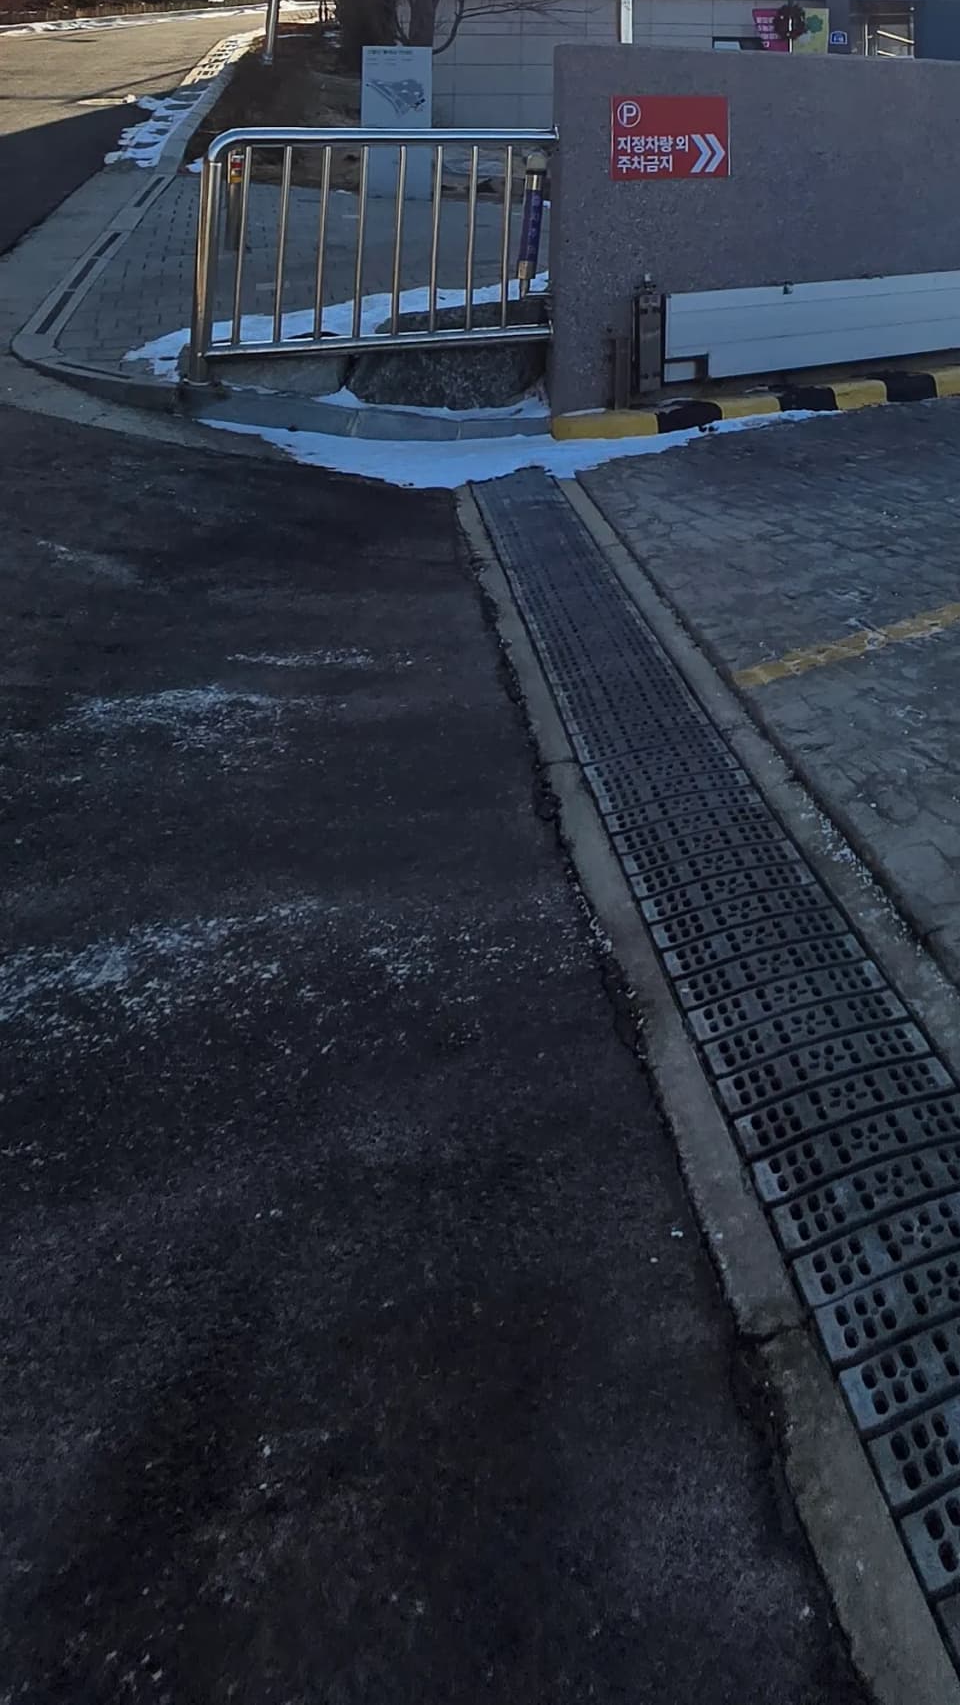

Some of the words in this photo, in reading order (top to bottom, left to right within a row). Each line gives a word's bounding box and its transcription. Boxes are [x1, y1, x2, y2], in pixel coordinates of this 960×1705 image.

[623, 104, 637, 124] P
[617, 135, 673, 153] 지정차량
[675, 134, 689, 152] 외
[617, 155, 673, 173] 주차금지
